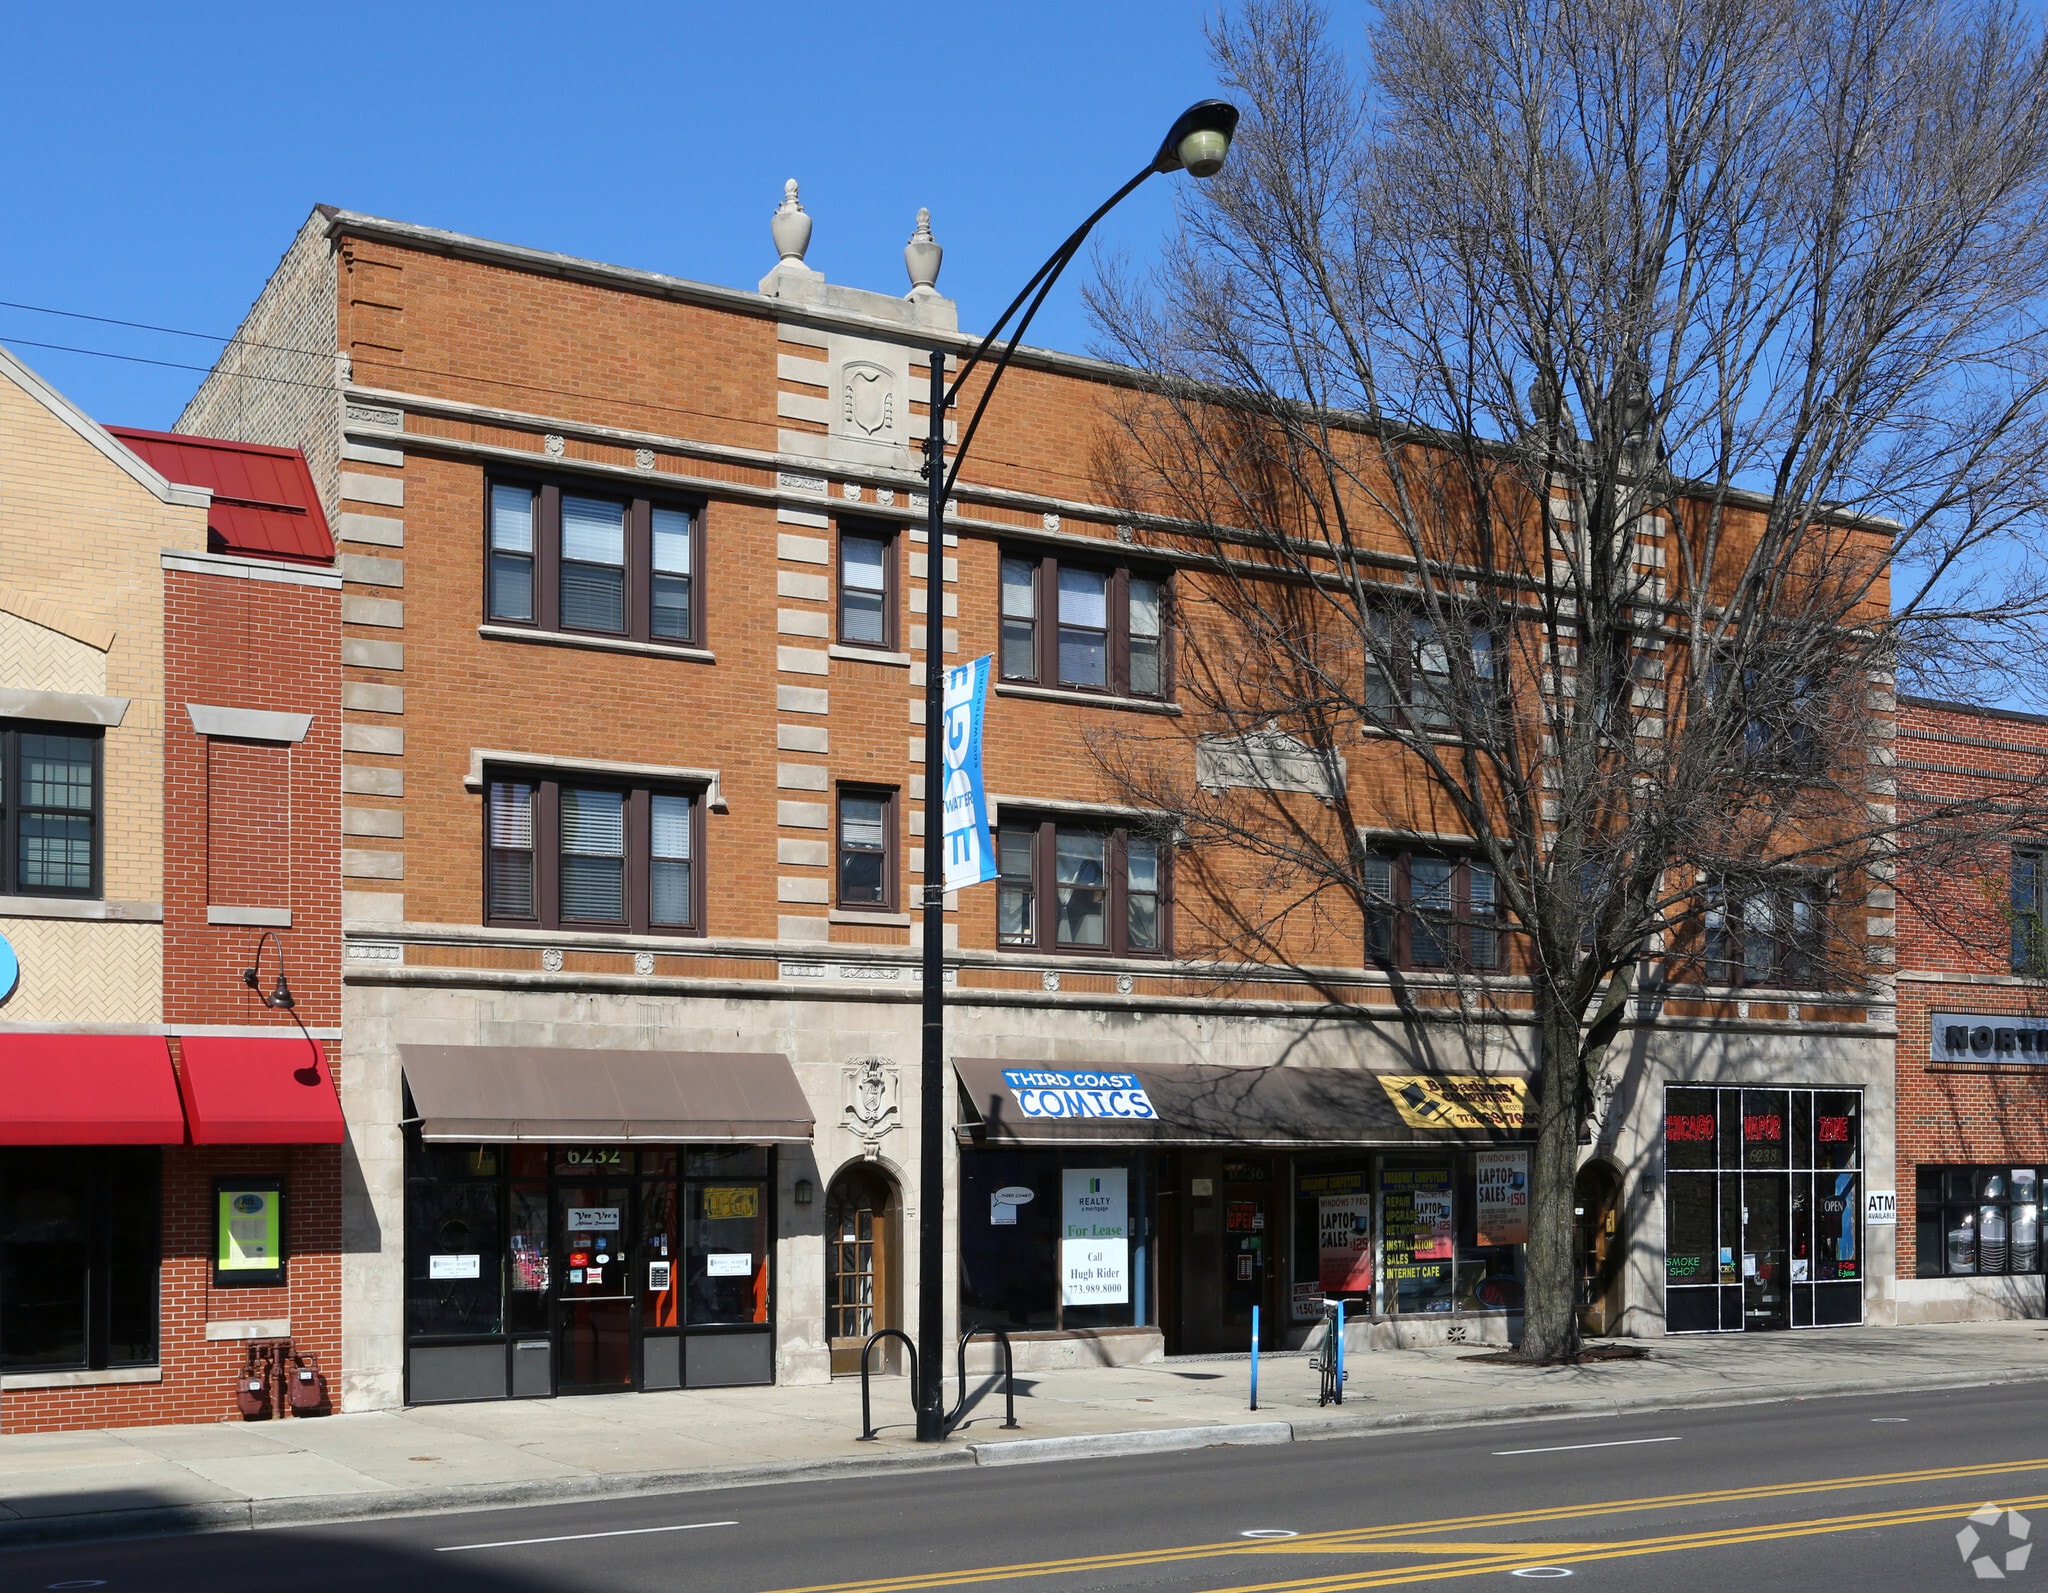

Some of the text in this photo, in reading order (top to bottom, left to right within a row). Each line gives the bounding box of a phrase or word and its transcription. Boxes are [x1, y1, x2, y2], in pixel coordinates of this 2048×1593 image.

[945, 795, 975, 815] WATER
[1006, 1072, 1132, 1088] THIRD COAST
[1425, 1080, 1515, 1096] Broadway
[1020, 1090, 1153, 1118] COMICS
[1442, 1092, 1512, 1104] COMPUTERS
[1743, 1114, 1781, 1141] VAPOR
[1818, 1116, 1849, 1142] ZONE
[567, 1150, 621, 1164] 6232
[1479, 1153, 1526, 1163] WINDOWS 10
[1750, 1150, 1778, 1163] 6238
[1479, 1168, 1513, 1185] LAPTOP
[1079, 1197, 1111, 1206] REALTY
[1320, 1199, 1349, 1208] WINDOWS
[1356, 1197, 1368, 1206] PRO
[1386, 1196, 1411, 1208] REPAIR
[1479, 1186, 1526, 1206] SALES $150
[1416, 1203, 1442, 1215] LAPTOP
[1824, 1200, 1844, 1212] OPEN
[1868, 1195, 1895, 1211] ATM
[574, 1212, 592, 1221] Vee
[1321, 1212, 1355, 1230] LAPTOP
[1386, 1210, 1419, 1222] UPGRADE
[1868, 1212, 1895, 1220] AVAILABLE
[1067, 1224, 1122, 1237] For Lease
[1321, 1231, 1369, 1251] SALES $125
[1386, 1240, 1434, 1252] INSTALLATION
[1088, 1252, 1103, 1262] Call
[1386, 1253, 1409, 1266] SALES
[1666, 1257, 1701, 1267] SMOKE
[1070, 1267, 1120, 1281] Hugh Rider
[1386, 1266, 1440, 1280] INTERNET CAFE
[1669, 1266, 1695, 1277] SHOP
[1069, 1283, 1122, 1295] 773.989.8000
